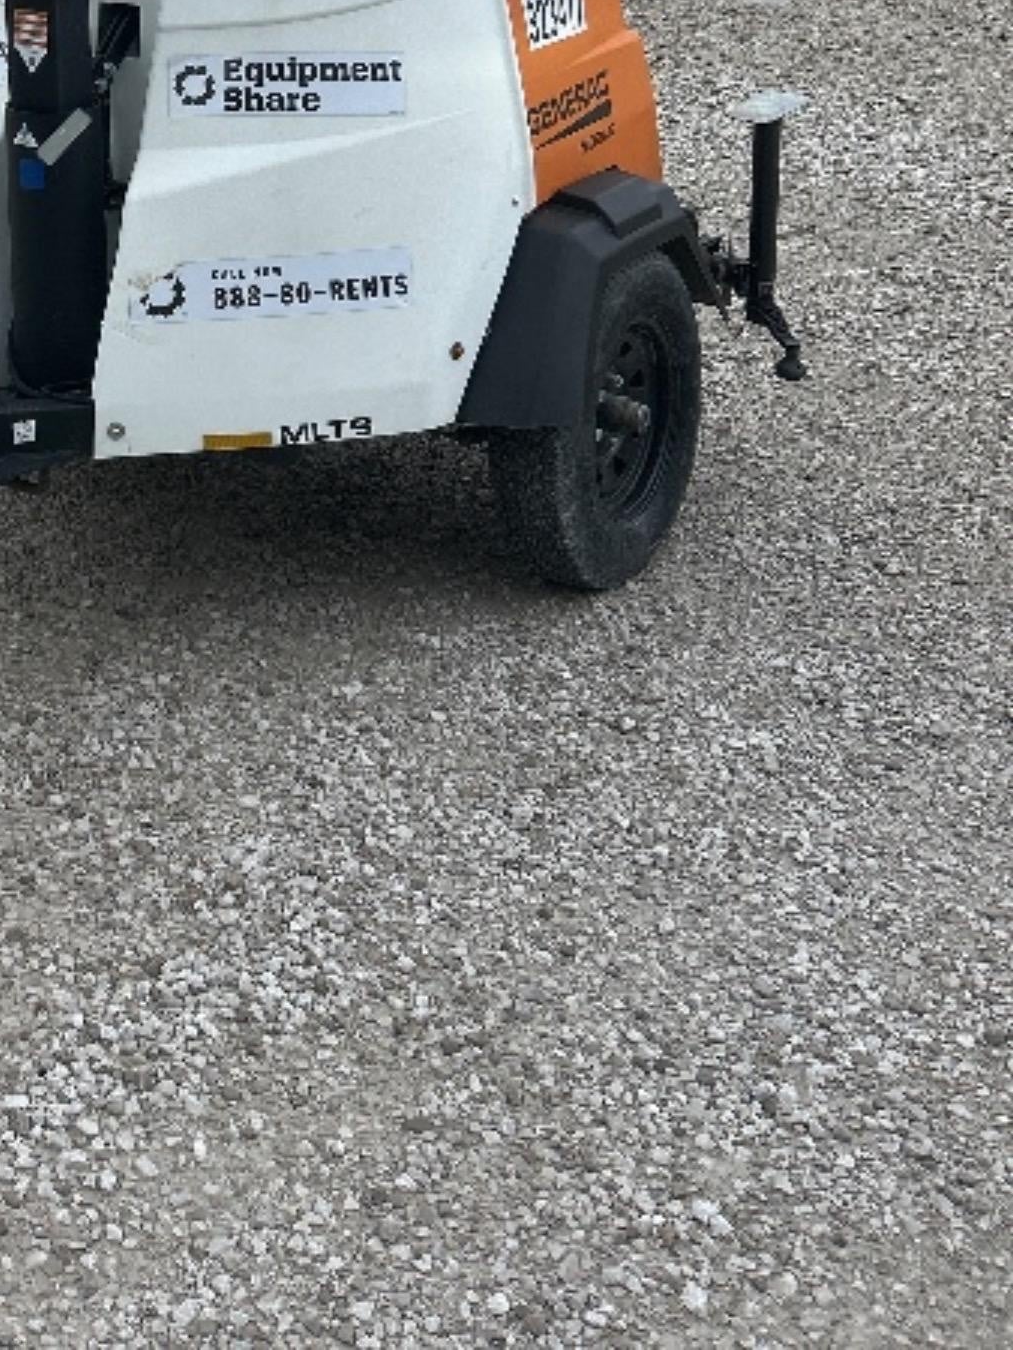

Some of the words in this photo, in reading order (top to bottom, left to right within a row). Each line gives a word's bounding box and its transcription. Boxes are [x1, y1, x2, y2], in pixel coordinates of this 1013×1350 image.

[223, 56, 403, 88] Equipment
[223, 86, 321, 112] Share
[527, 69, 610, 137] GENERAC
